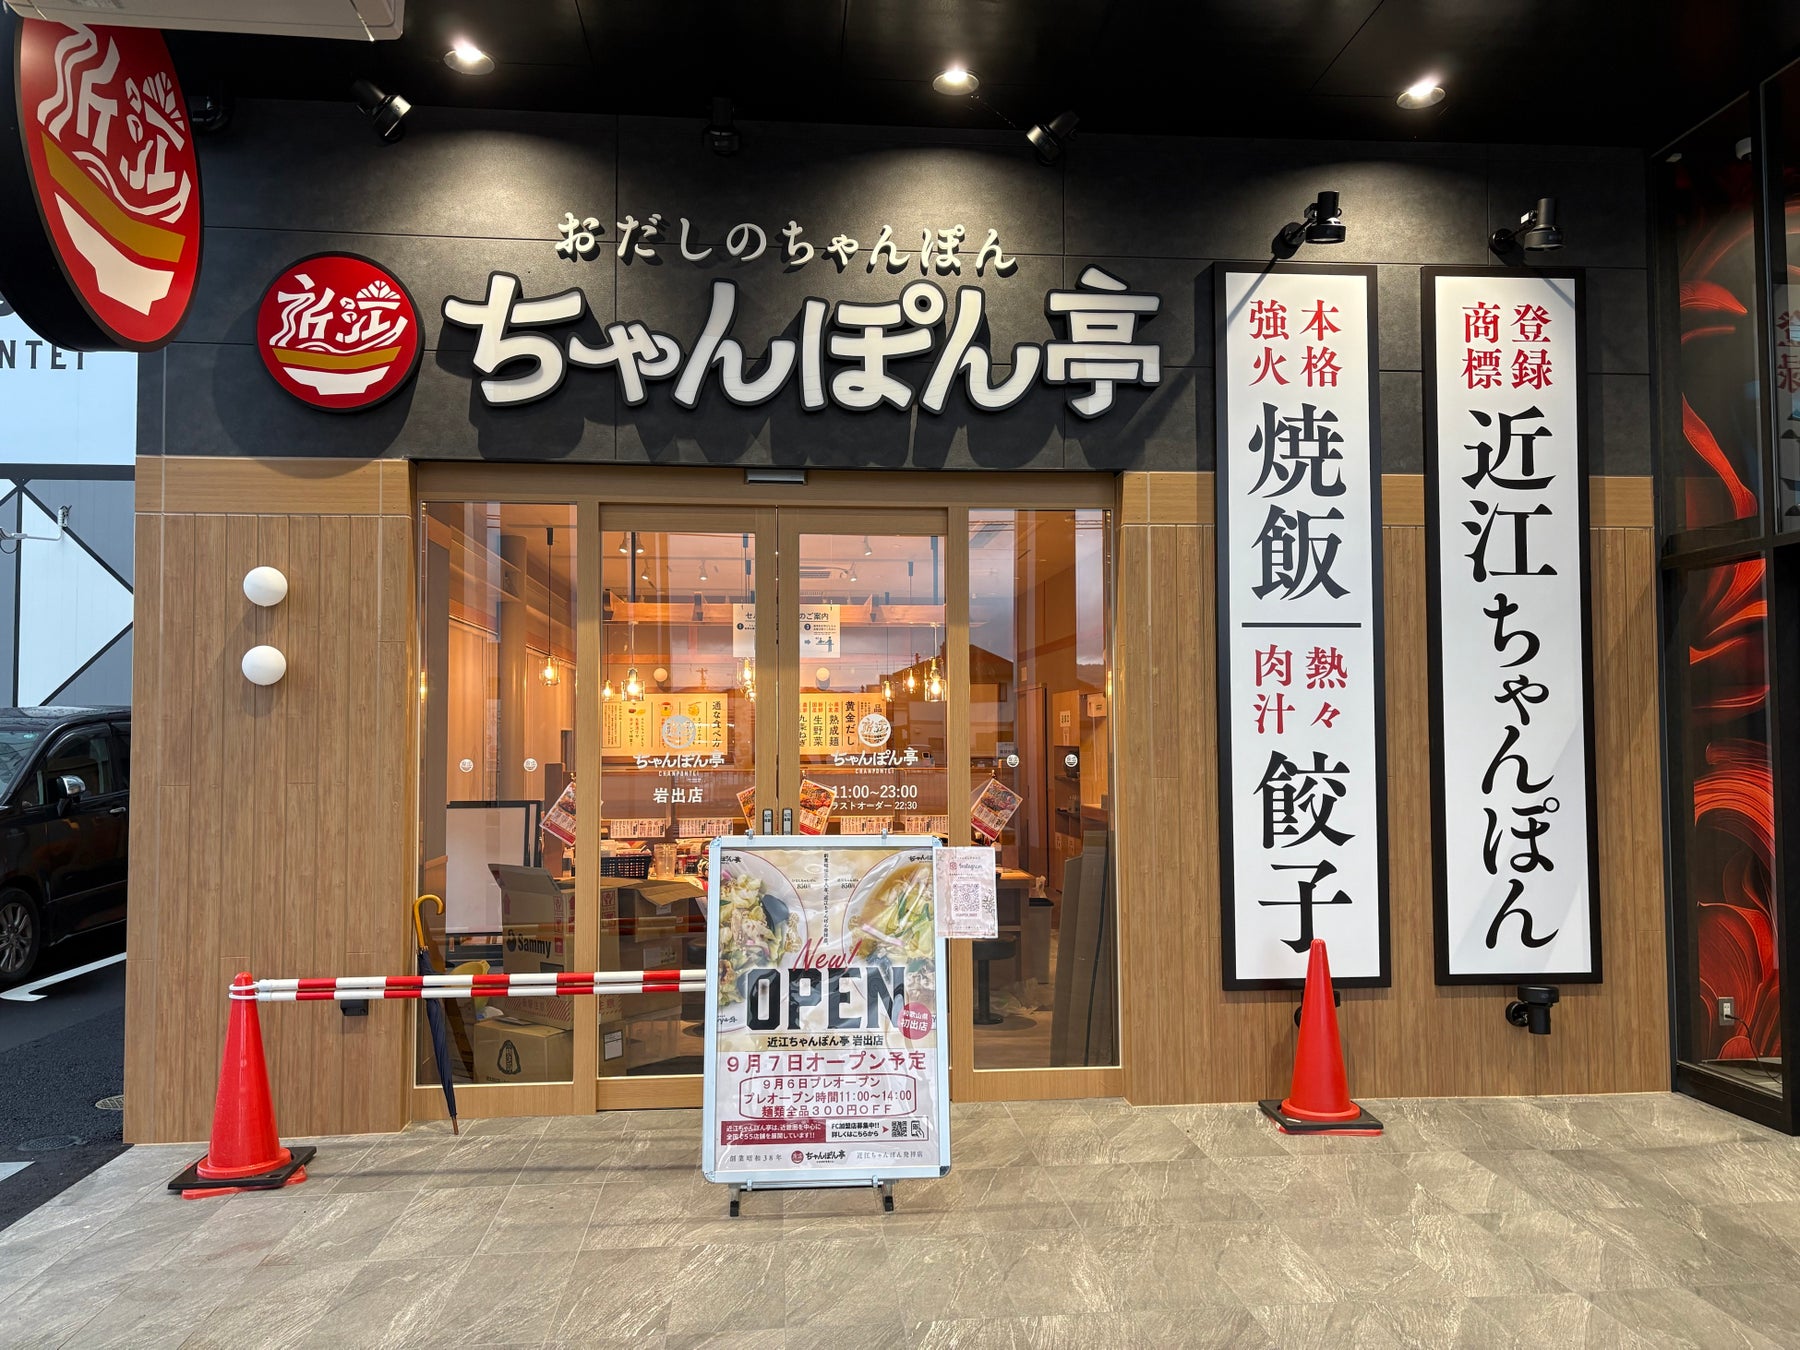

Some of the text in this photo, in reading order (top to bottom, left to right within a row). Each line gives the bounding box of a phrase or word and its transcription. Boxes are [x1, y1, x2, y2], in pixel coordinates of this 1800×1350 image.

[555, 211, 1018, 274] おだしのちゃんぽん
[443, 265, 1163, 418] ちゃんぽん亭
[1249, 299, 1290, 387] 強火
[1300, 299, 1343, 388] 本格
[1461, 301, 1503, 390] 商標
[1510, 303, 1554, 391] 登録
[1247, 402, 1351, 601] 焼飯
[1253, 644, 1295, 734] 肉汁
[1305, 646, 1349, 729] 熱々
[1461, 405, 1561, 950] 近江ちゃんぽん
[845, 700, 856, 747] 黄金だし
[632, 750, 725, 769] ちゃんぽん亭
[831, 747, 919, 767] ちゃんぽん亭
[653, 787, 704, 804] 岩出店
[832, 801, 918, 810] ラストオーダー 22:30
[1253, 750, 1356, 954] 餃子
[517, 933, 552, 959] Sammy
[793, 937, 863, 972] New!
[746, 966, 906, 1031] OPEN
[726, 1051, 927, 1073] 9月7日オープン予定
[767, 1034, 884, 1048] 近江ちゃんぽん亭 岩出店
[763, 1077, 881, 1091] 9月6日プレオープン
[831, 1130, 879, 1138] 詳しくはこちらから
